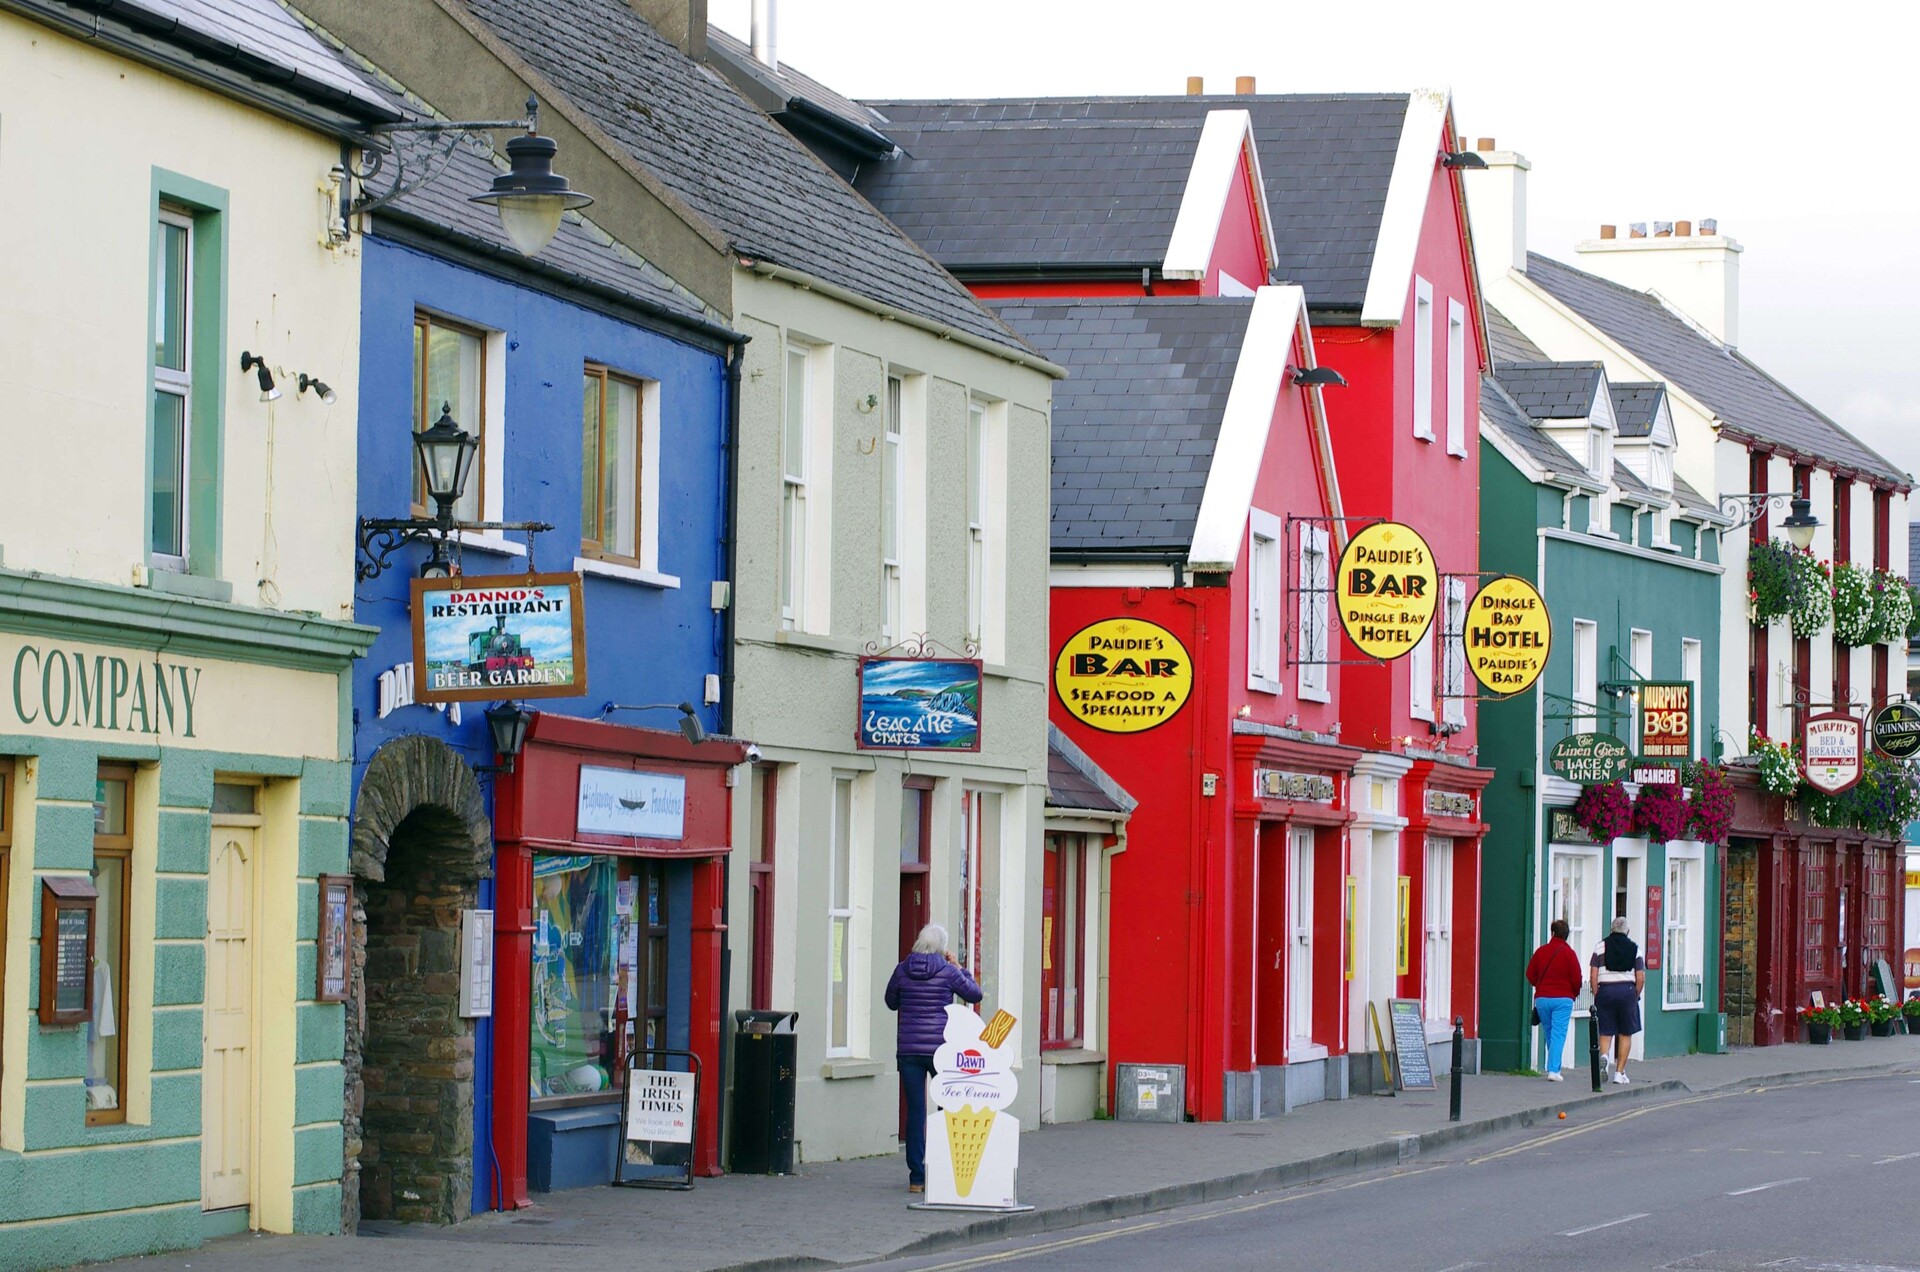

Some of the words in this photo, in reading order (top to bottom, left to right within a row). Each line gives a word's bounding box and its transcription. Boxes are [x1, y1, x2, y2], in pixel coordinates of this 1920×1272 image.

[1355, 546, 1423, 565] PAUDIE'S
[1348, 568, 1428, 598] BAR
[450, 588, 545, 604] DANNO'S
[1481, 596, 1535, 610] DINGLE
[432, 600, 564, 617] RESTAURANT
[1348, 610, 1395, 623] DINGLE
[1400, 612, 1426, 624] BAY
[1491, 612, 1523, 626] BAY
[1359, 625, 1412, 643] HOTEL
[1471, 627, 1543, 649] HOTEL
[1089, 635, 1164, 651] PAUDIE'S
[1070, 653, 1180, 678] BAR
[1477, 657, 1537, 670] PAUDIE'S
[435, 671, 482, 688] BEER
[489, 667, 567, 685] GARDEN
[1491, 672, 1523, 684] BAR
[13, 645, 201, 738] COMPANY
[1071, 687, 1155, 702] SEAFOOD
[1163, 691, 1176, 702] A
[1644, 686, 1688, 709] MURPHYS
[1081, 702, 1166, 717] SPECIALITY
[1644, 711, 1688, 736] B&B
[1809, 722, 1856, 736] MURPHY'S
[1876, 721, 1920, 735] GUINNESS
[1576, 734, 1594, 747] The
[1820, 736, 1837, 746] BED
[1839, 736, 1845, 746] &
[1557, 743, 1591, 757] Linen
[1593, 742, 1626, 758] Chest
[1809, 746, 1856, 756] BREAKFAST
[1567, 758, 1602, 770] LACE
[1604, 757, 1614, 769] &
[1569, 769, 1610, 780] LINEN
[1633, 768, 1676, 785] VACANCIES
[956, 1053, 985, 1070] Dawn
[648, 1075, 677, 1088] THE
[642, 1087, 681, 1101] IRISH
[942, 1086, 962, 1098] Ice
[964, 1085, 1000, 1099] Cream
[639, 1100, 684, 1113] TIMES
